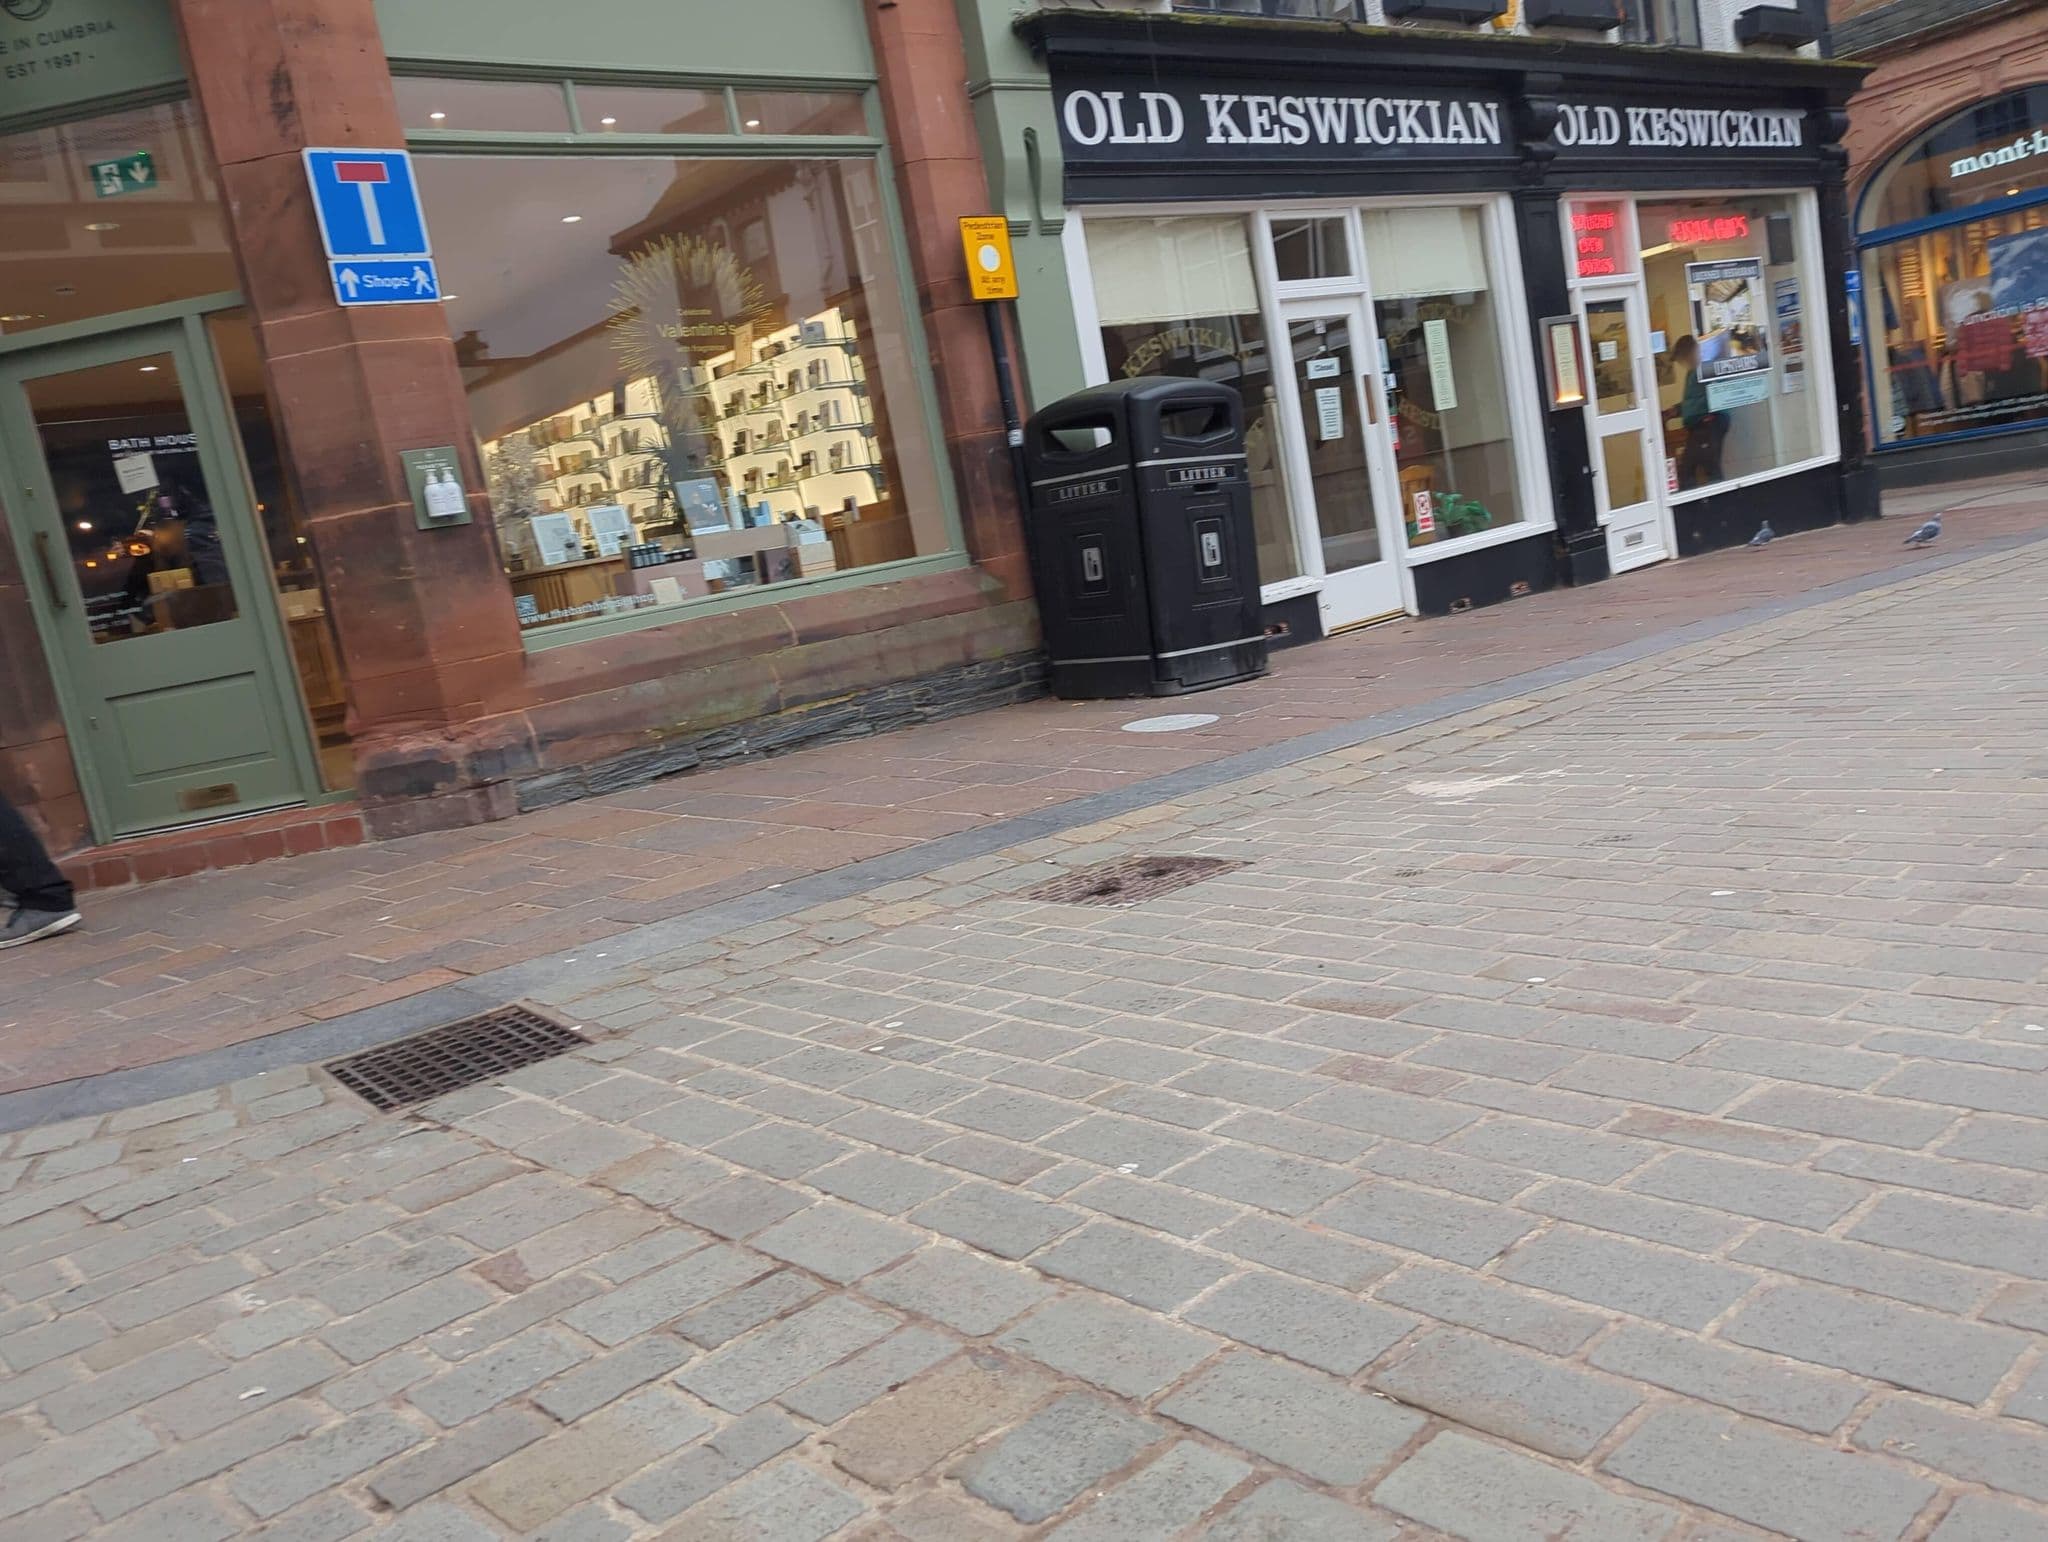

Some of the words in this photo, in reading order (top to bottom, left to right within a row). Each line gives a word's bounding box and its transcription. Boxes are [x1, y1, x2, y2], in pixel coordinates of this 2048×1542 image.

[13, 38, 31, 50] IN
[37, 21, 116, 46] CUMBRIA
[7, 62, 36, 79] EST
[1064, 90, 1184, 145] OLD
[1201, 94, 1500, 144] KESWICKIAN
[1553, 104, 1620, 146] OLD
[1625, 107, 1803, 147] KESWICKIAN
[963, 221, 1003, 230] Pedestrian
[976, 231, 995, 241] Zone
[362, 274, 411, 289] Shops
[656, 321, 737, 338] Valentine's
[108, 437, 151, 450] BATH
[1180, 467, 1227, 481] LITTER
[1059, 482, 1108, 500] LITTER
